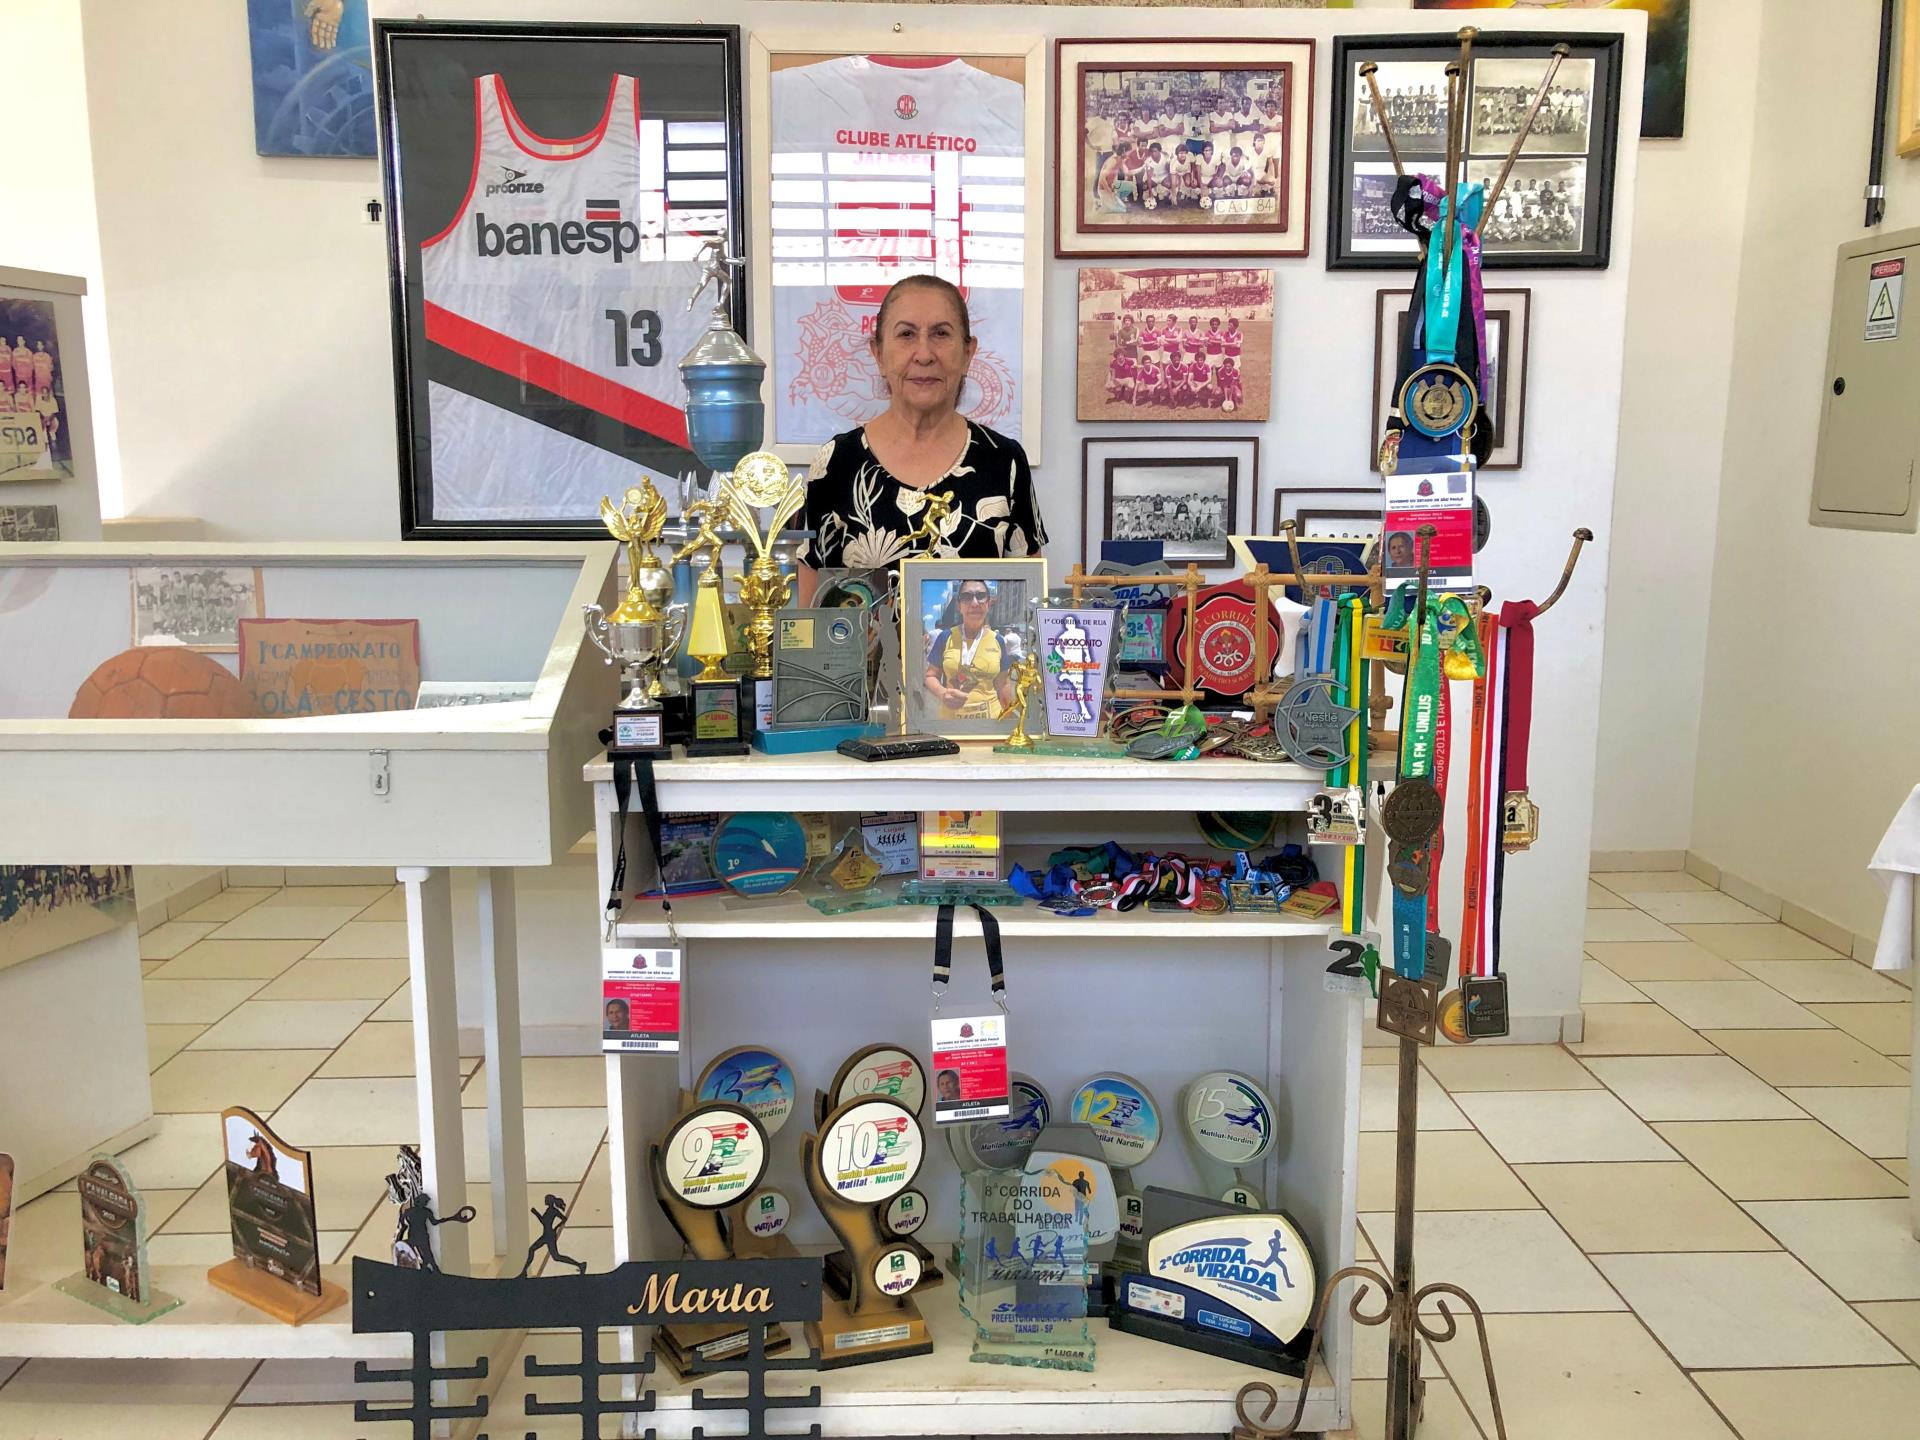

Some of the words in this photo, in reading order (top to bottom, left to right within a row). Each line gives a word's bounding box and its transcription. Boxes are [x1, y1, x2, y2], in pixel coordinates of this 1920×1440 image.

[836, 129, 890, 147] CLUBE
[895, 131, 977, 152] ATLÉTICO
[1256, 198, 1274, 212] 84
[476, 212, 640, 263] banesp
[605, 309, 663, 367] 13
[782, 621, 796, 632] 1º
[271, 642, 401, 660] CAMPEONATO
[335, 688, 412, 714] CESTO
[1065, 692, 1093, 702] LUGAR
[1061, 713, 1087, 724] RAX
[1416, 694, 1432, 733] UNILUS
[1414, 742, 1427, 758] FM
[755, 1106, 787, 1119] ardini
[1080, 1088, 1118, 1126] 12
[837, 1121, 879, 1172] 10
[1116, 1137, 1144, 1149] Nardini
[682, 1127, 713, 1179] 9
[683, 1184, 711, 1195] Matilat
[717, 1180, 745, 1191] Nardini
[837, 1178, 868, 1190] Matilat
[875, 1172, 905, 1184] Nardini
[999, 1185, 1061, 1198] CORRIDA
[1013, 1199, 1033, 1210] DO
[971, 1211, 1073, 1224] TRABALHADOR
[1172, 1247, 1247, 1266] CORRIDA
[1184, 1264, 1195, 1273] da
[1197, 1263, 1277, 1292] VIRADA
[627, 1273, 774, 1314] Maria
[991, 1313, 1033, 1323] PREFEITURA
[1015, 1324, 1040, 1334] TANABI
[1044, 1324, 1054, 1334] SP
[1054, 1349, 1085, 1359] LUGAR
